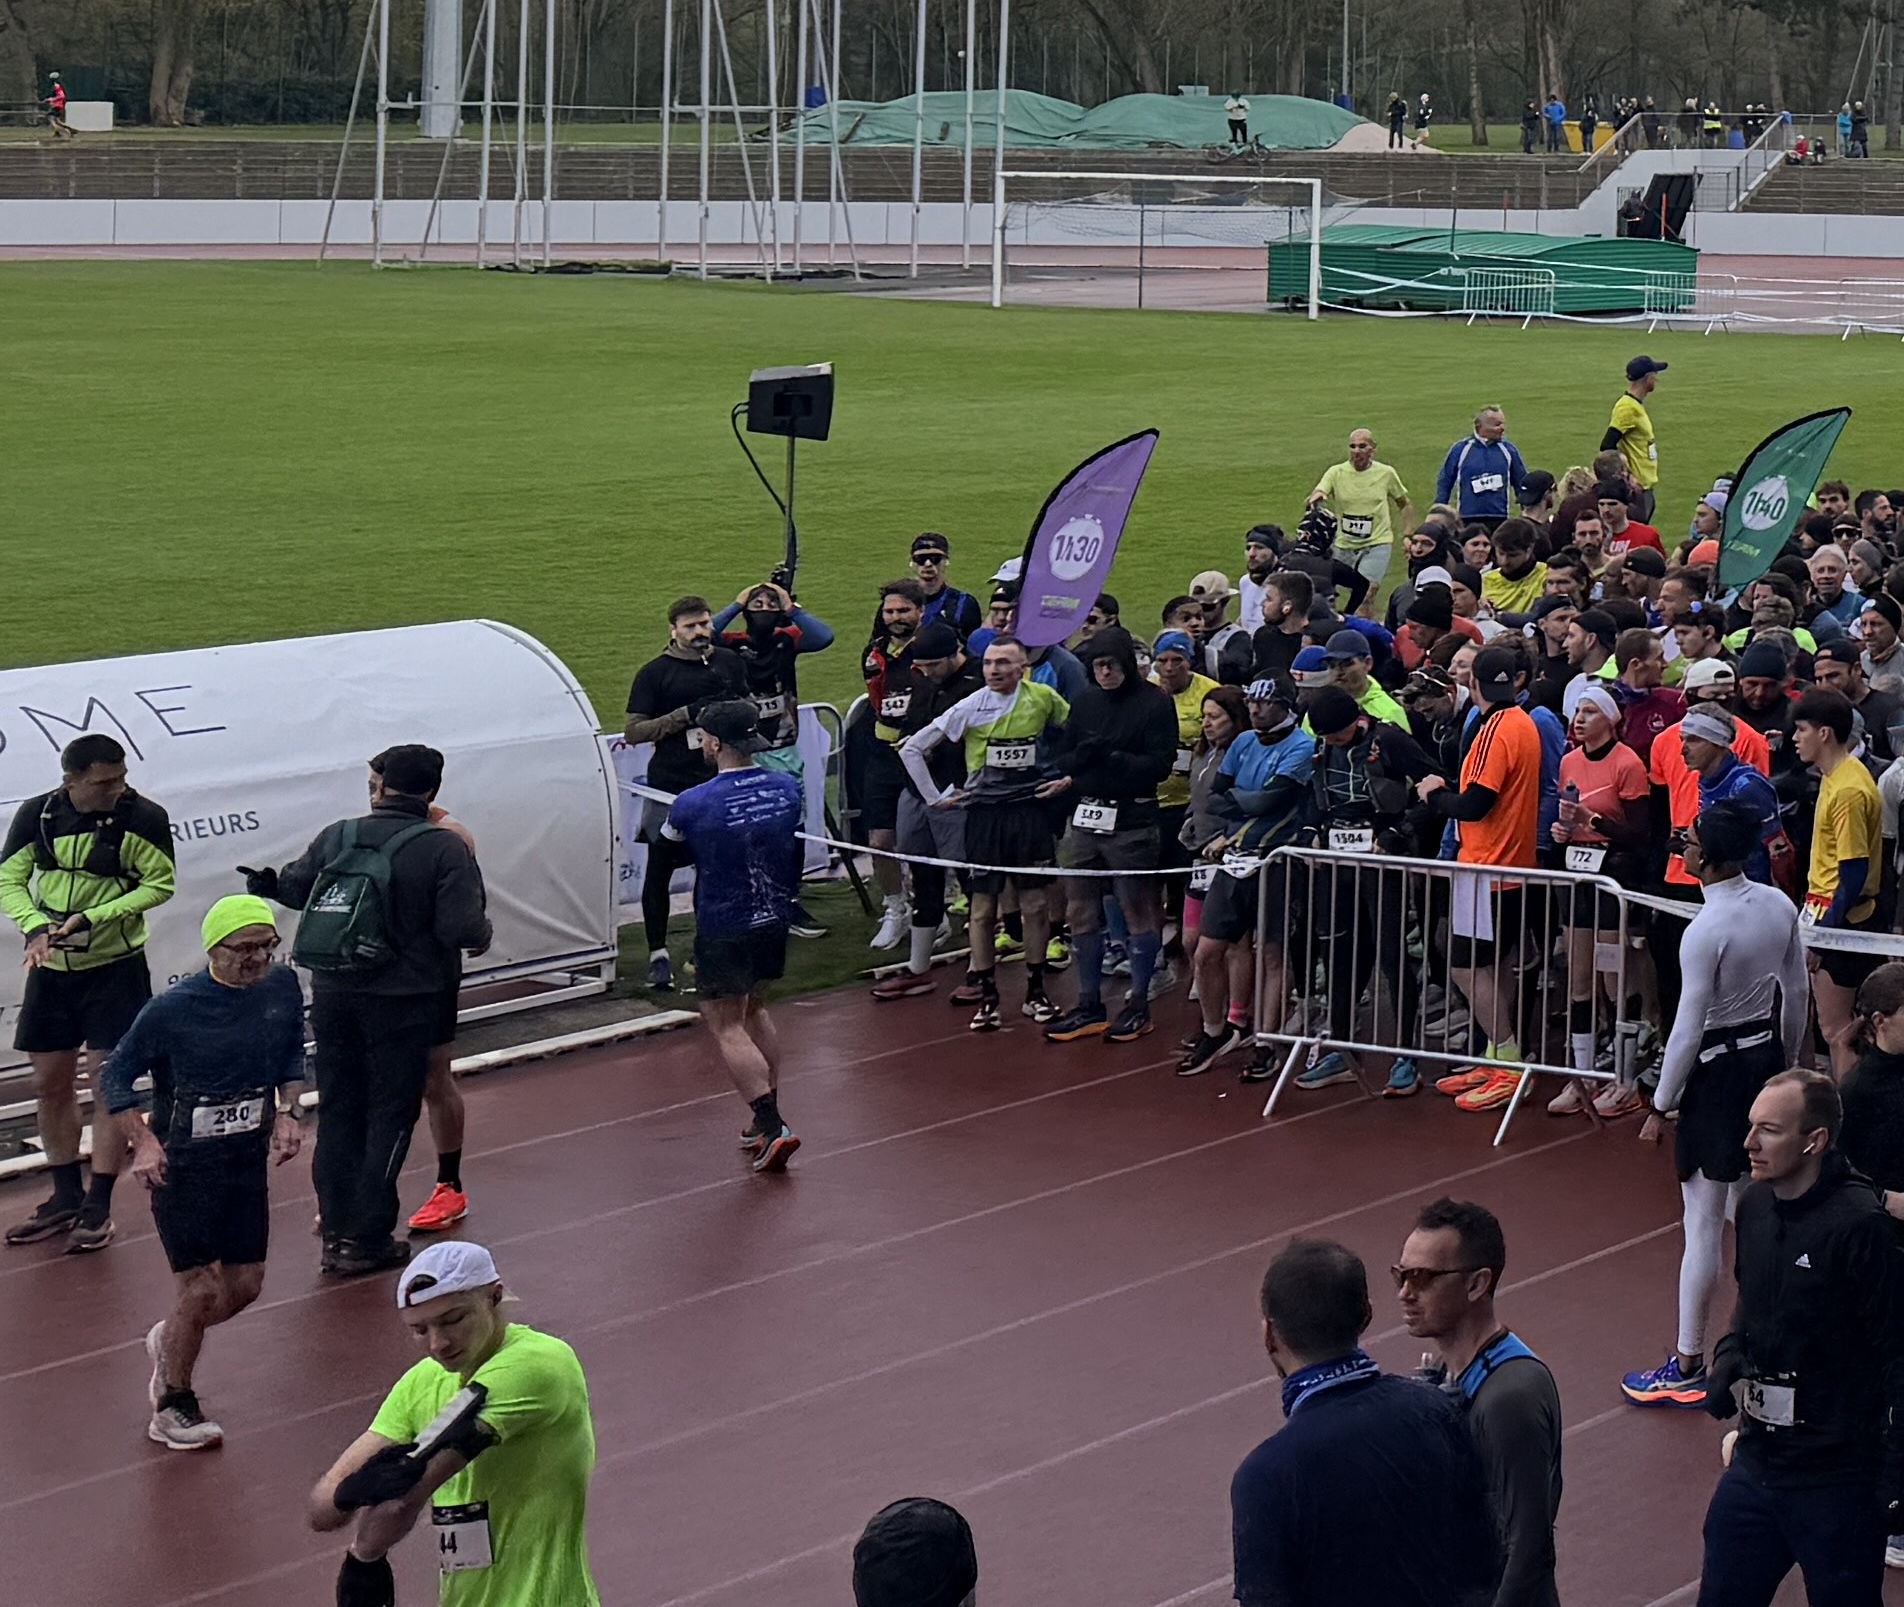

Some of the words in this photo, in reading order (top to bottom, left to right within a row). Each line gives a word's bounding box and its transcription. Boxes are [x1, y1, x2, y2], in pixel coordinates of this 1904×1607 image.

[1055, 534, 1101, 563] 1h30
[0, 685, 227, 761] ME
[1573, 850, 1593, 863] 772
[214, 1106, 250, 1125] 280
